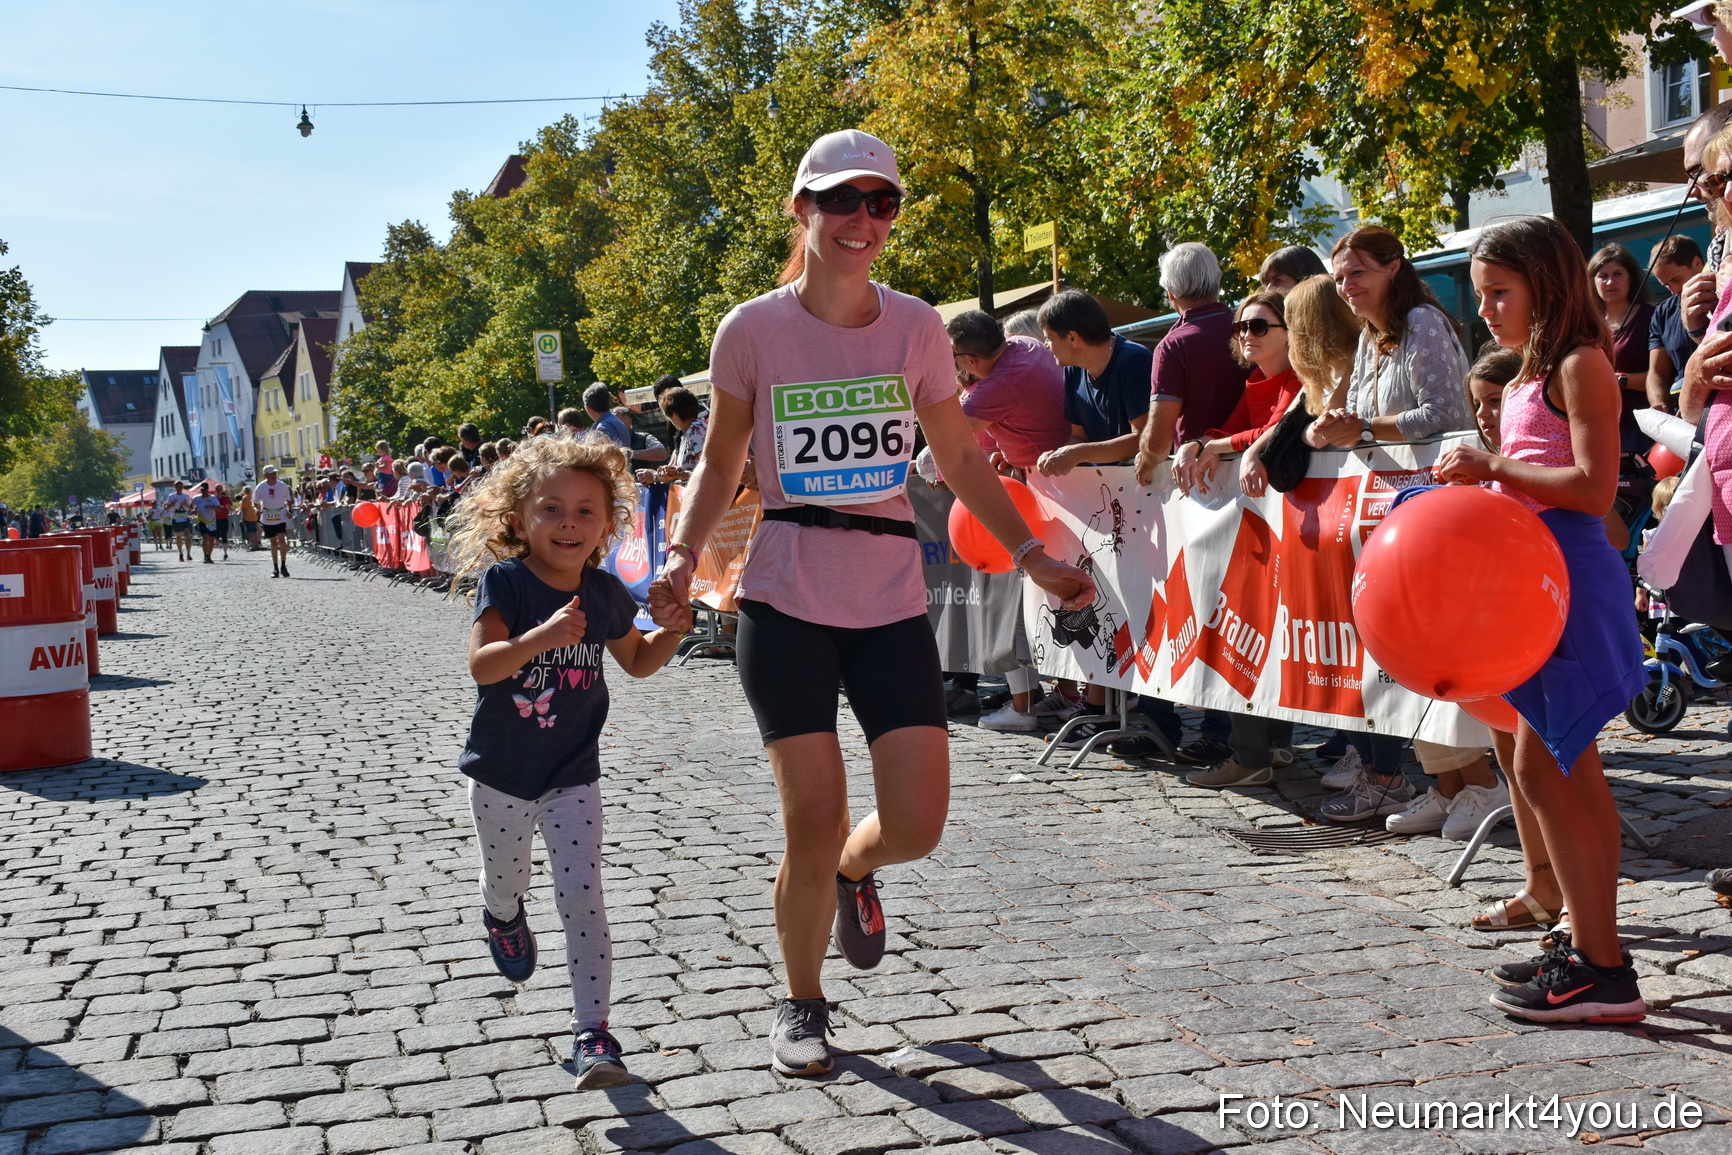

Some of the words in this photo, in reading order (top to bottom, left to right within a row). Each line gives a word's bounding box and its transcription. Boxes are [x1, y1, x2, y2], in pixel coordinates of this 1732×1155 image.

[1029, 230, 1053, 244] Toiletten
[786, 382, 902, 415] BOCK
[793, 419, 904, 464] 2096
[804, 469, 895, 493] MELANIE
[1336, 523, 1345, 543] Seit
[1341, 494, 1353, 519] 1929
[1168, 615, 1196, 667] Braun
[1206, 590, 1266, 667] Braun
[1279, 604, 1358, 667] Braun
[1222, 646, 1236, 666] Sicher
[1234, 659, 1244, 671] ist
[531, 666, 552, 690] OF
[1307, 670, 1329, 687] Sicher
[1331, 673, 1342, 688] ist
[1343, 673, 1363, 691] sicher
